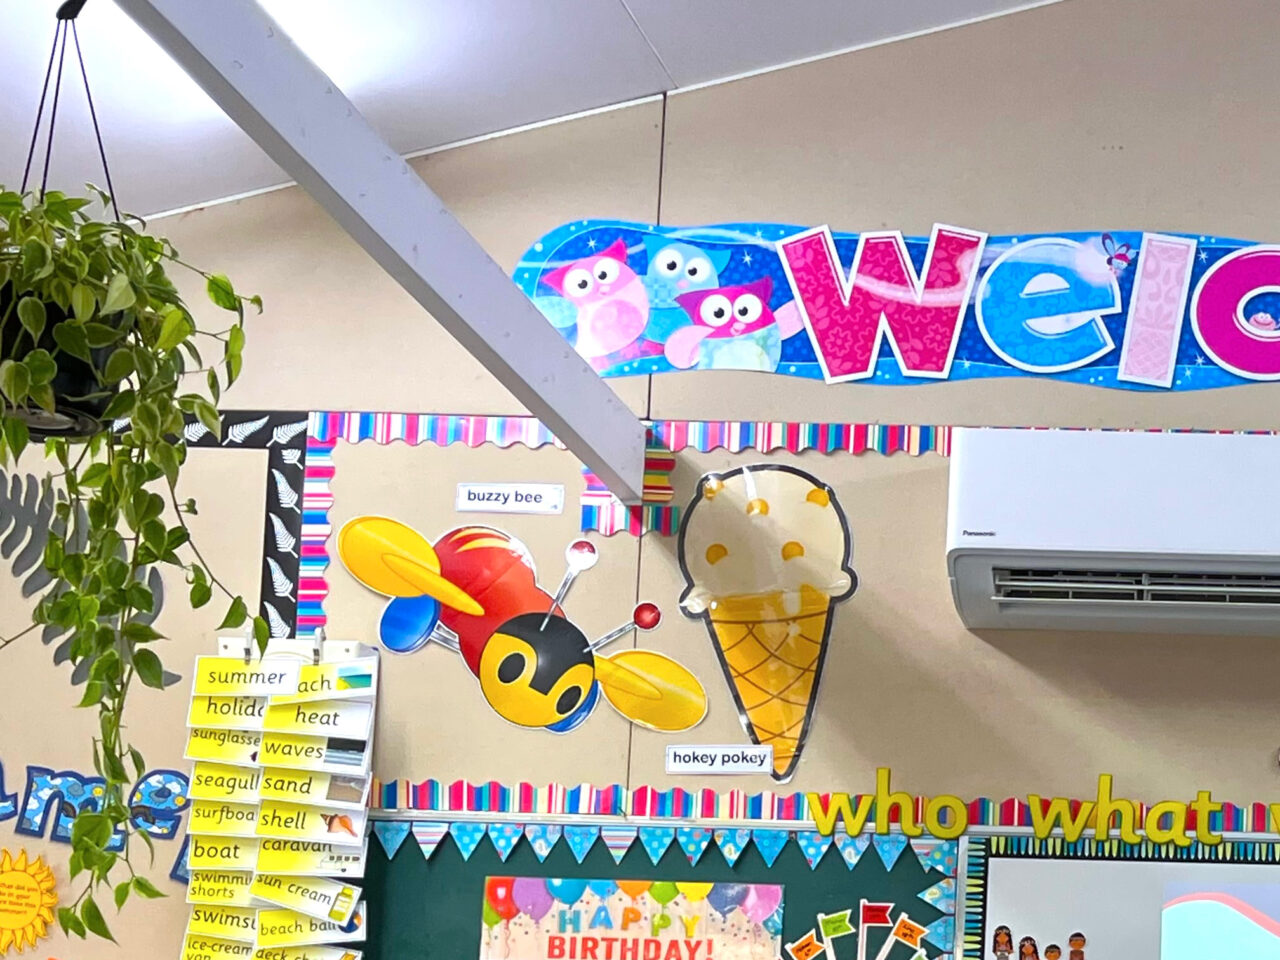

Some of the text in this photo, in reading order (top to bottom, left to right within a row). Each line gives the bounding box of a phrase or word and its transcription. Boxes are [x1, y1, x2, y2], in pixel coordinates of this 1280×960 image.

[467, 489, 543, 504] buzzy bee
[962, 529, 996, 537] Panasonic
[207, 670, 288, 684] summer
[295, 705, 341, 727] heat
[264, 741, 324, 760] waves
[673, 750, 767, 767] hokey pokey
[263, 776, 313, 795] sand
[807, 767, 967, 839] who
[1028, 773, 1223, 846] what
[260, 809, 307, 830] shell
[193, 838, 241, 860] boat
[262, 840, 333, 853] caravan
[189, 885, 236, 899] shorts
[257, 873, 333, 906] sun cream
[260, 919, 304, 936] beach
[557, 905, 702, 938] HAPPY
[187, 938, 253, 956] ice-cream
